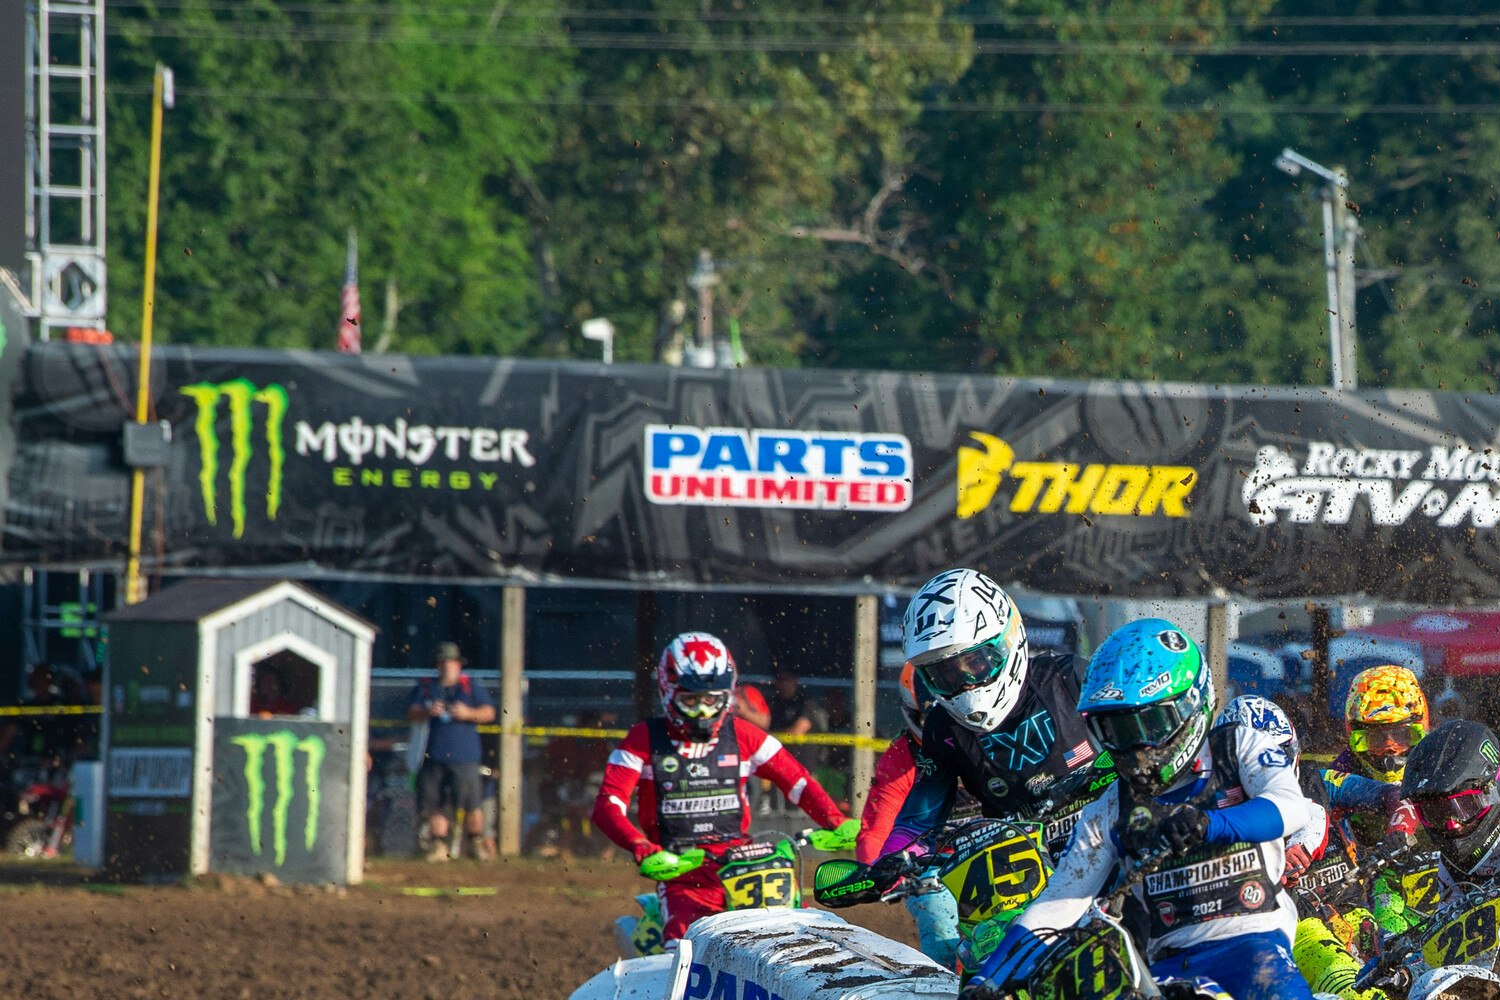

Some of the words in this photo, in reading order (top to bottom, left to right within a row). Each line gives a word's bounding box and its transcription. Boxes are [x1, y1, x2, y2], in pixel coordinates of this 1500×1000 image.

[295, 416, 535, 468] MONSTER
[652, 431, 910, 478] PARTS
[1304, 441, 1423, 479] ROCKY
[333, 467, 499, 491] ENERGY
[652, 475, 909, 506] UNLIMITED
[1009, 462, 1199, 517] THOR
[663, 797, 736, 812] CHAMPIONSHIP
[734, 871, 792, 911] 33
[820, 879, 876, 900] ACERBIS
[960, 838, 1043, 917] 45
[1148, 851, 1257, 892] CHAMPIONSHIP
[1192, 898, 1223, 916] 2021
[1437, 904, 1496, 966] 29
